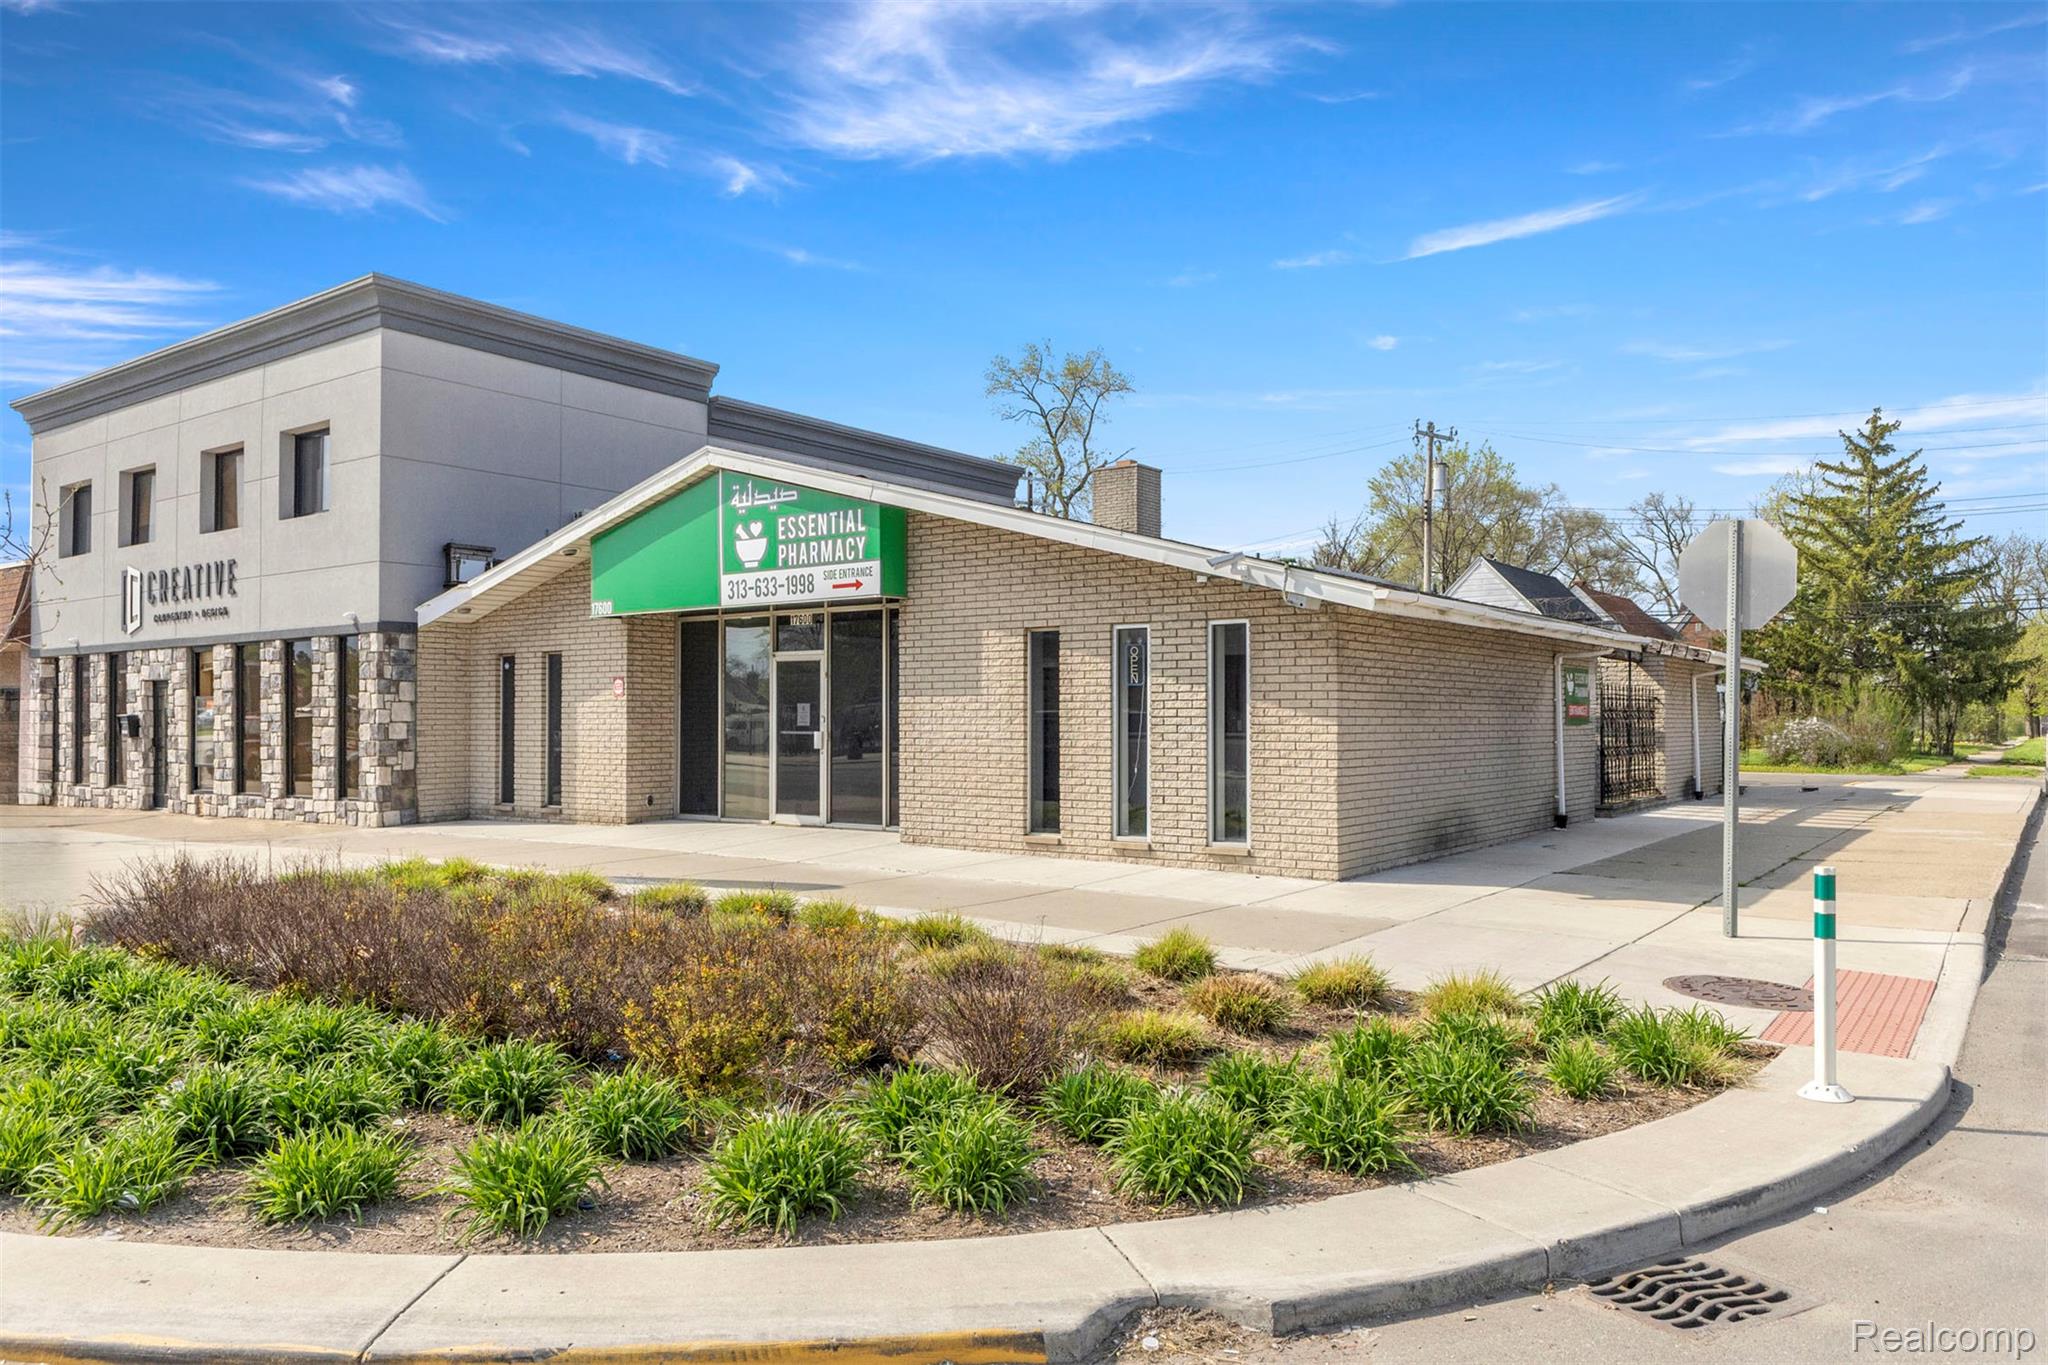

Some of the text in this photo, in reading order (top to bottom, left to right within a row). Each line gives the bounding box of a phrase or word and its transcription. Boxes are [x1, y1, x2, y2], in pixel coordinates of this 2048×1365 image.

[731, 480, 798, 514] صيدلية
[778, 509, 866, 540] ESSENTIAL
[778, 537, 866, 567] PHARMACY
[147, 558, 238, 606] CREATIVE
[728, 573, 815, 600] 313-633-1998
[823, 566, 873, 581] SIDE ENTRANCE
[201, 606, 229, 618] DESIGN
[790, 614, 813, 626] 17600
[1130, 646, 1139, 684] OPEN
